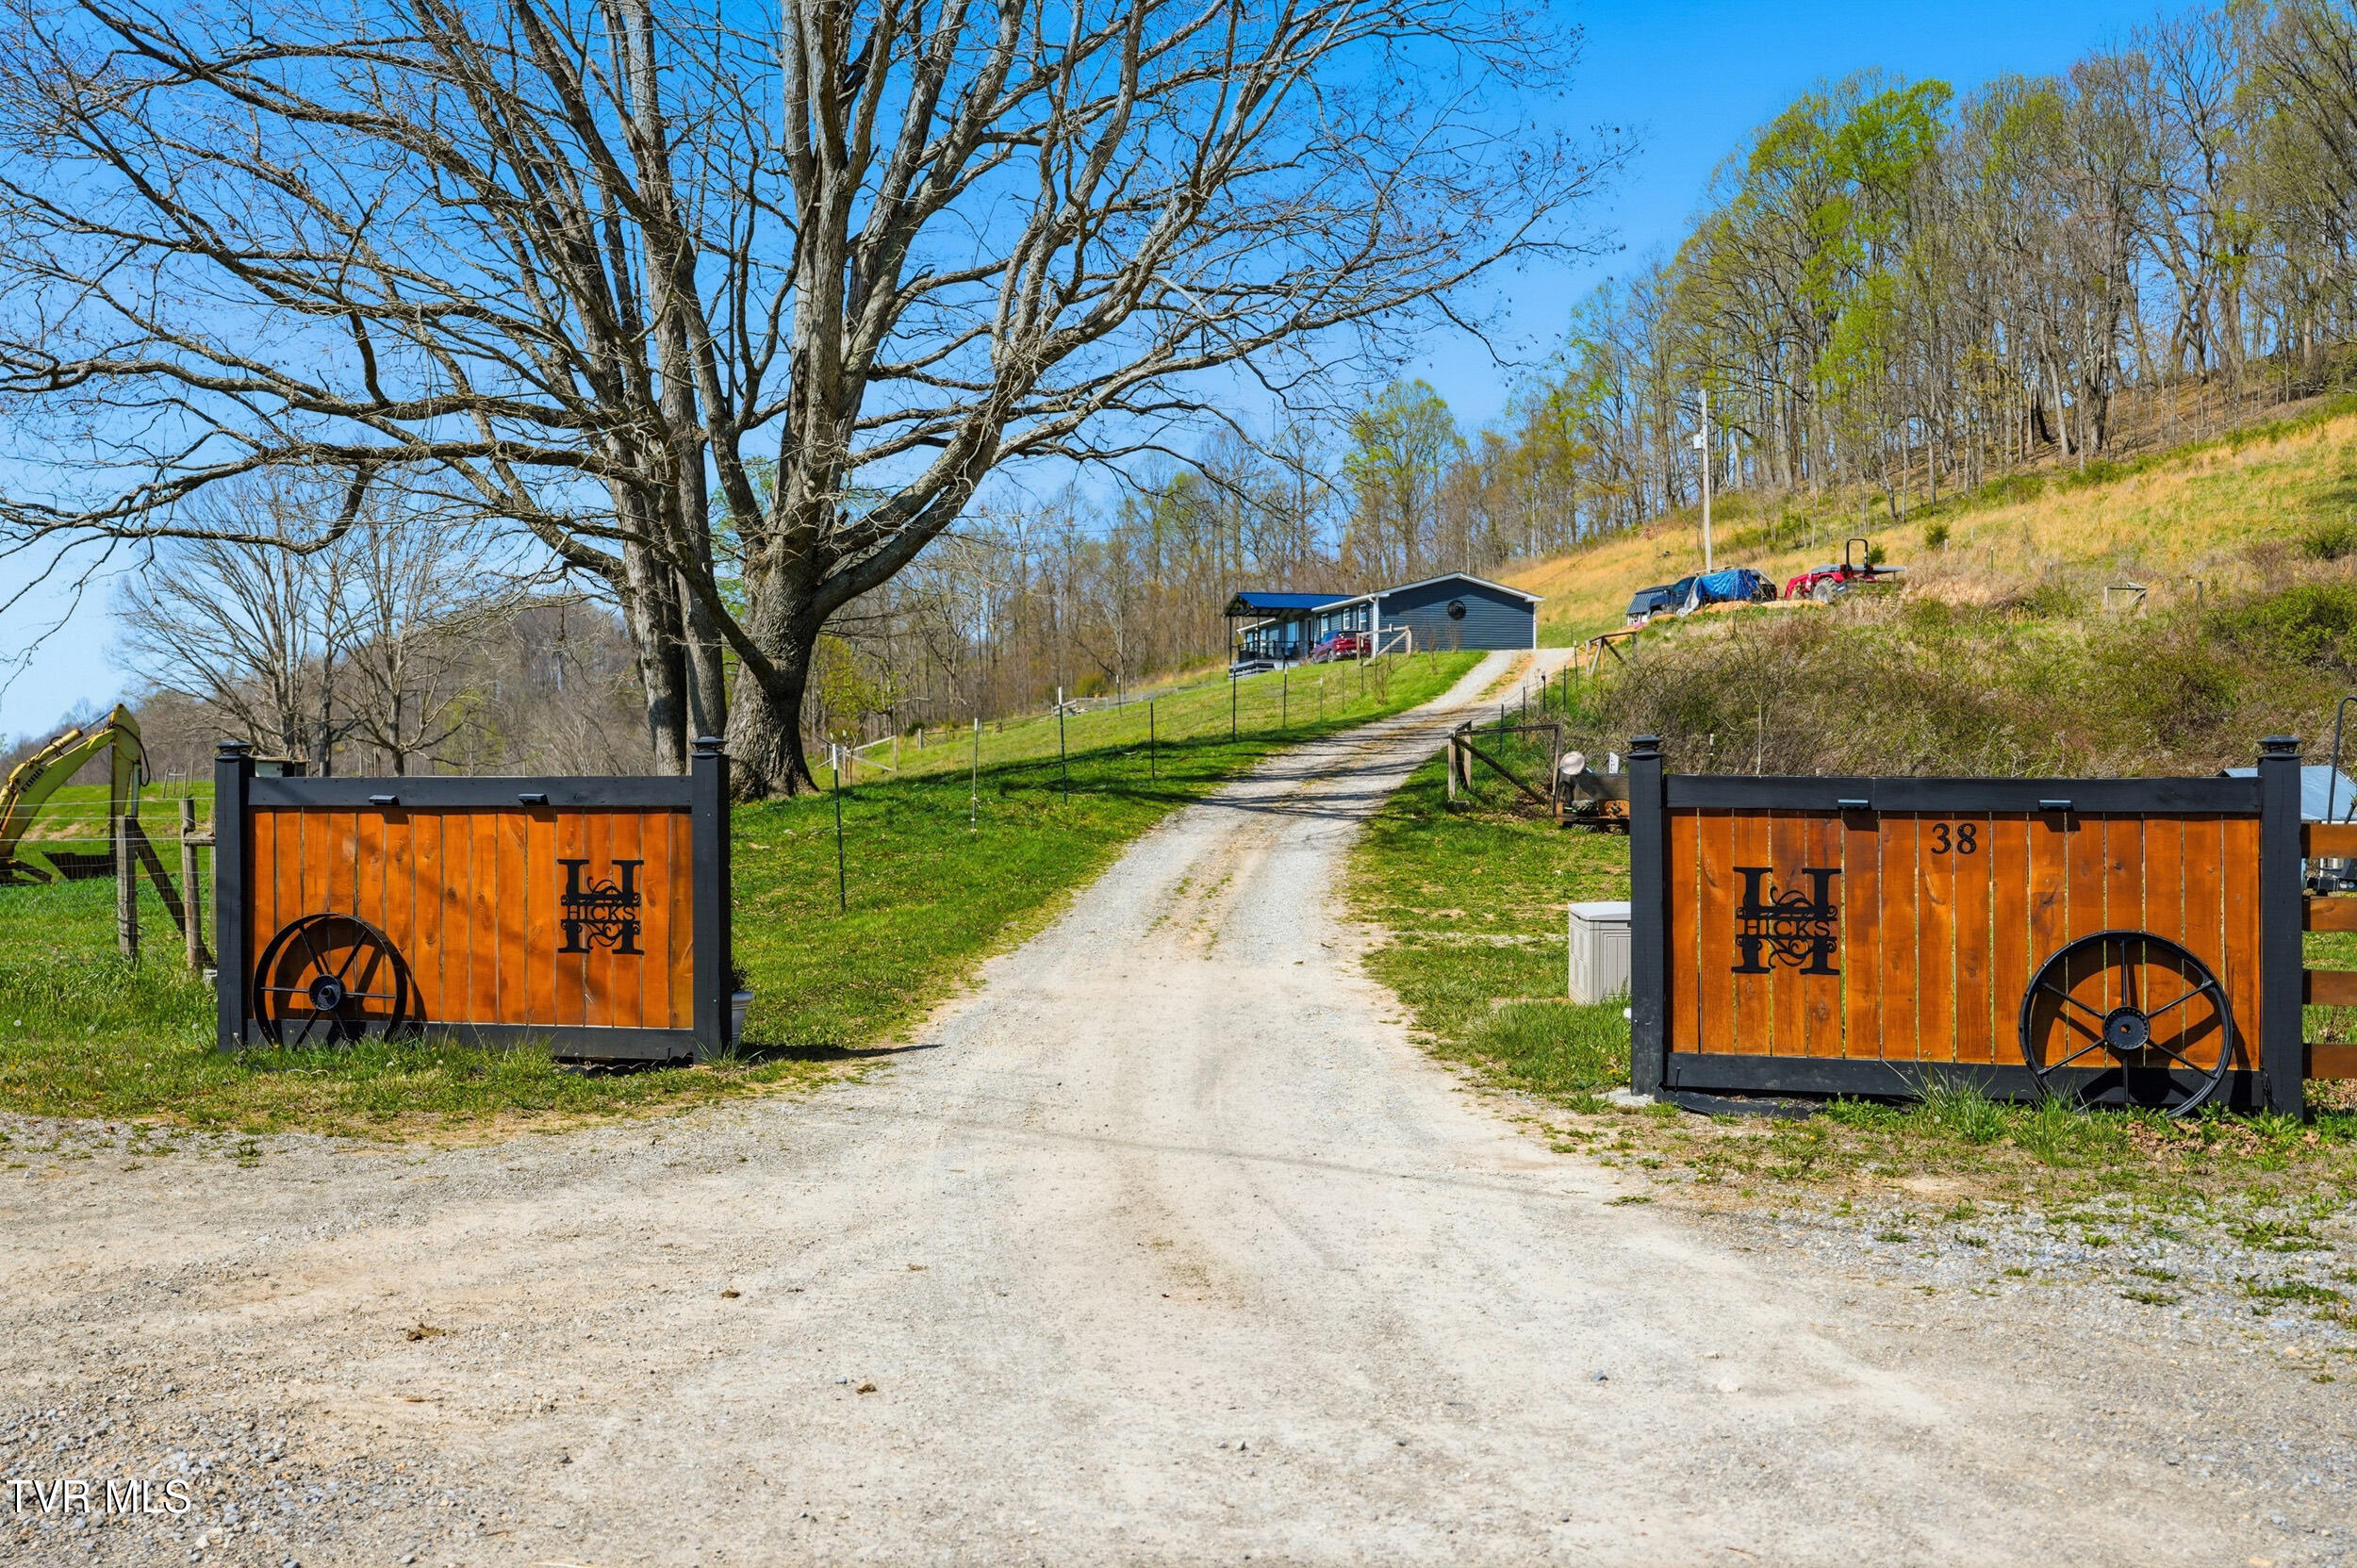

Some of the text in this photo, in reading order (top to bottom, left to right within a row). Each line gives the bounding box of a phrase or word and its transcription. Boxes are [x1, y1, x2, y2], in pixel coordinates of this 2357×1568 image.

[1931, 823, 1977, 854] 38
[568, 905, 635, 922] HICKS
[1744, 918, 1831, 937] HICKS
